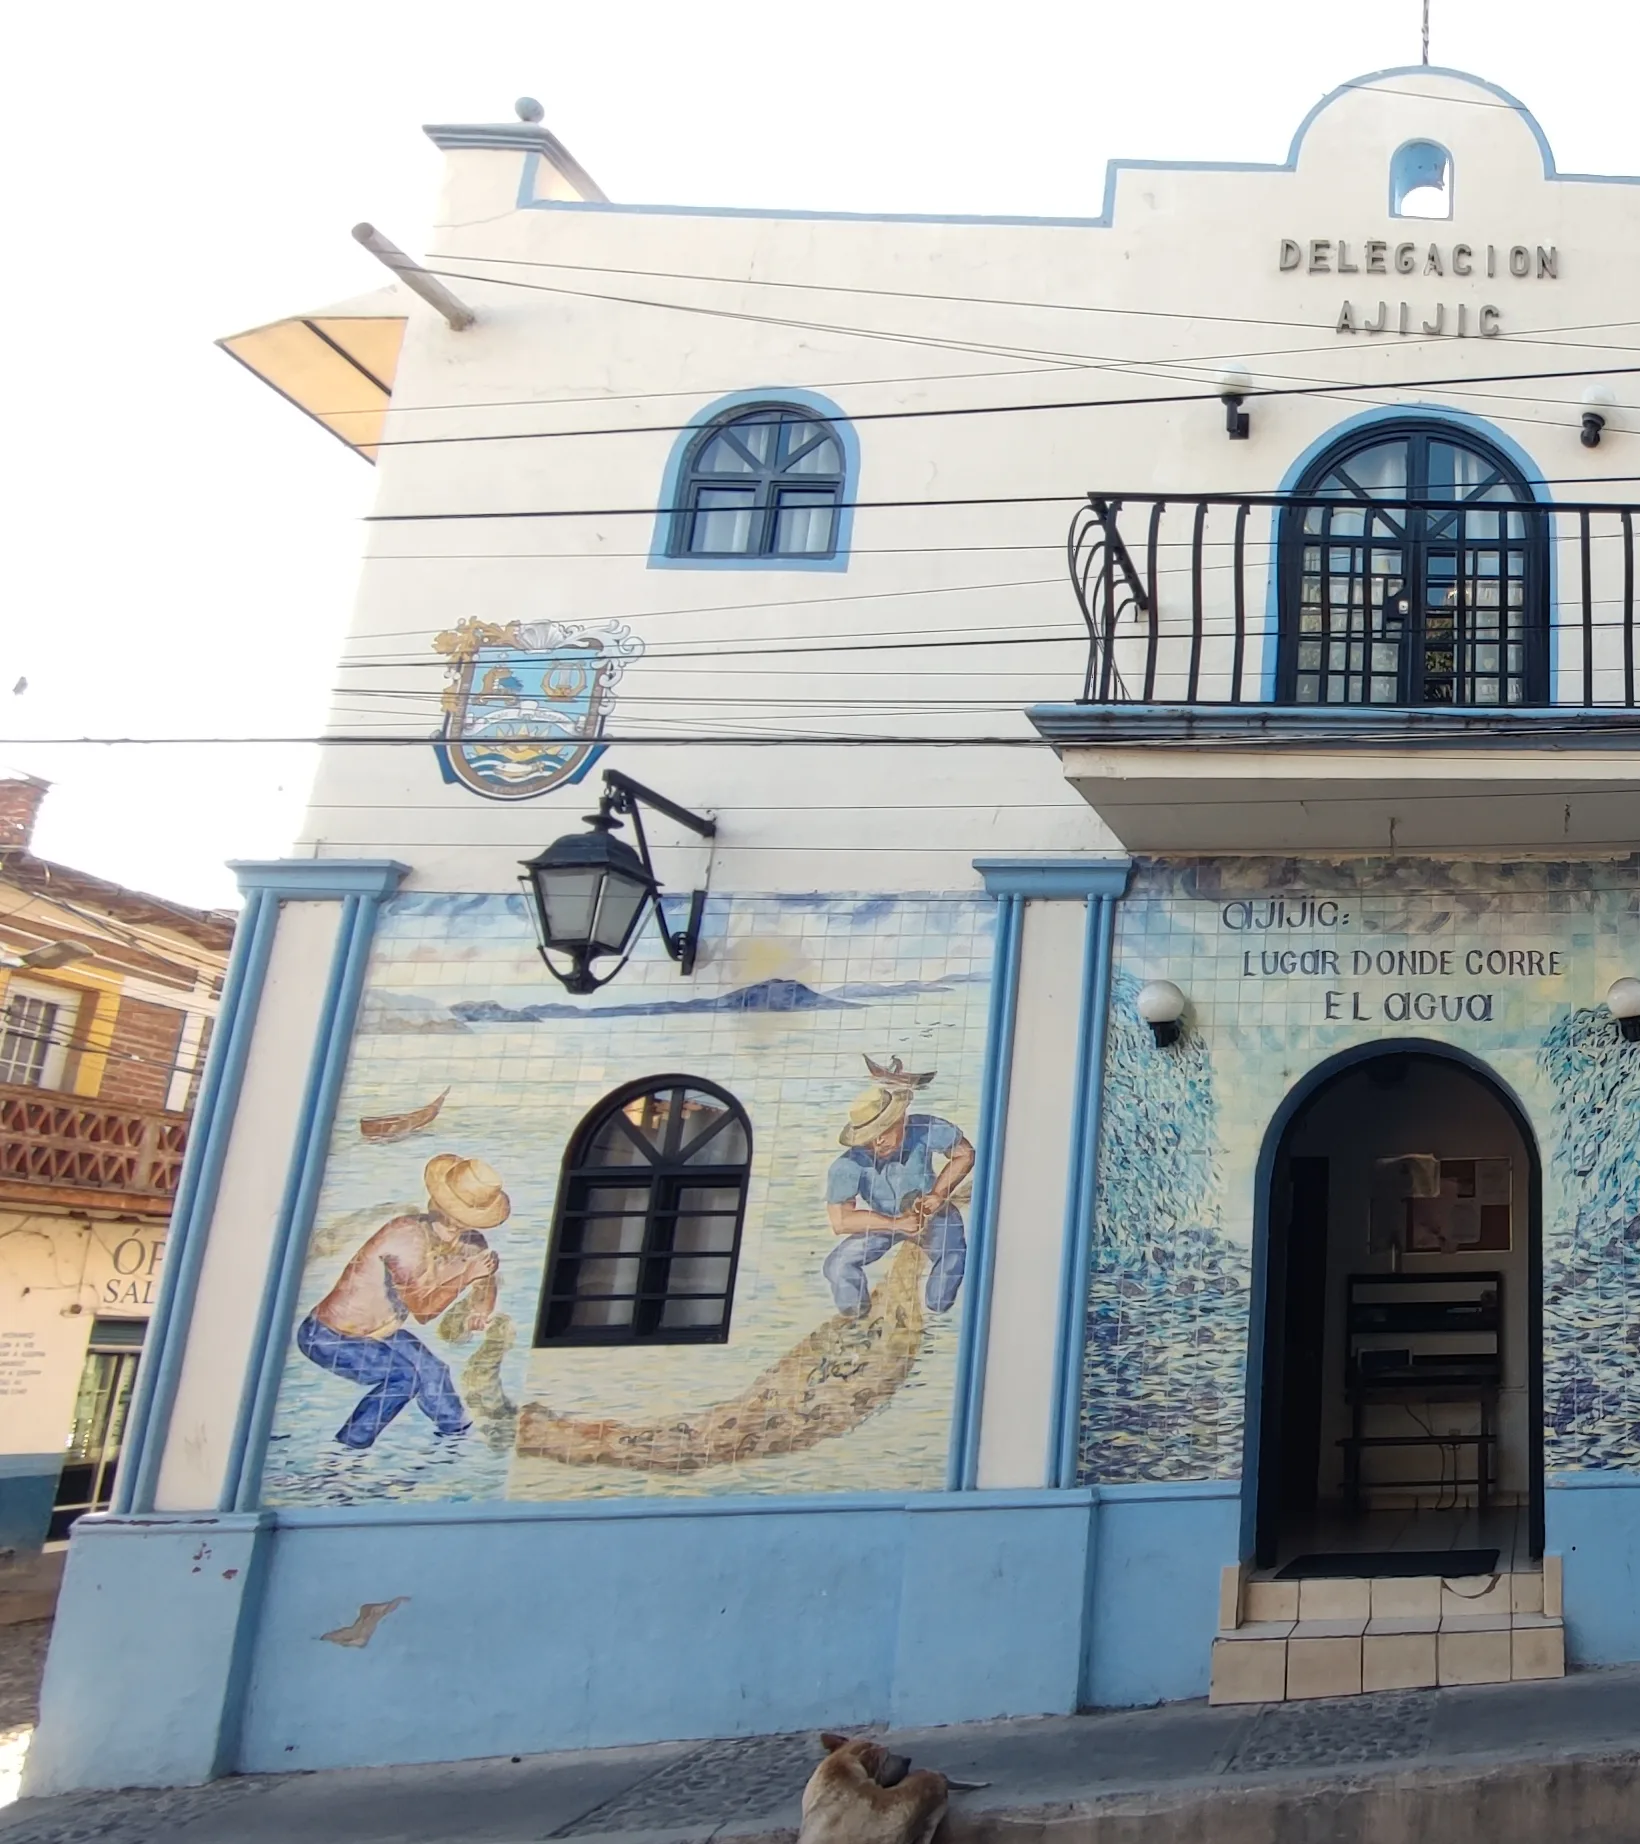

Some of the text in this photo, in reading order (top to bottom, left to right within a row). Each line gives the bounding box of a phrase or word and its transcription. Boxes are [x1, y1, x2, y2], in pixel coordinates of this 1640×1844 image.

[1279, 239, 1557, 279] DELEGACION
[1336, 300, 1500, 337] AJIJIC
[1351, 950, 1456, 977] DONDE
[1465, 950, 1564, 977] CORRE
[1324, 990, 1372, 1022] EL
